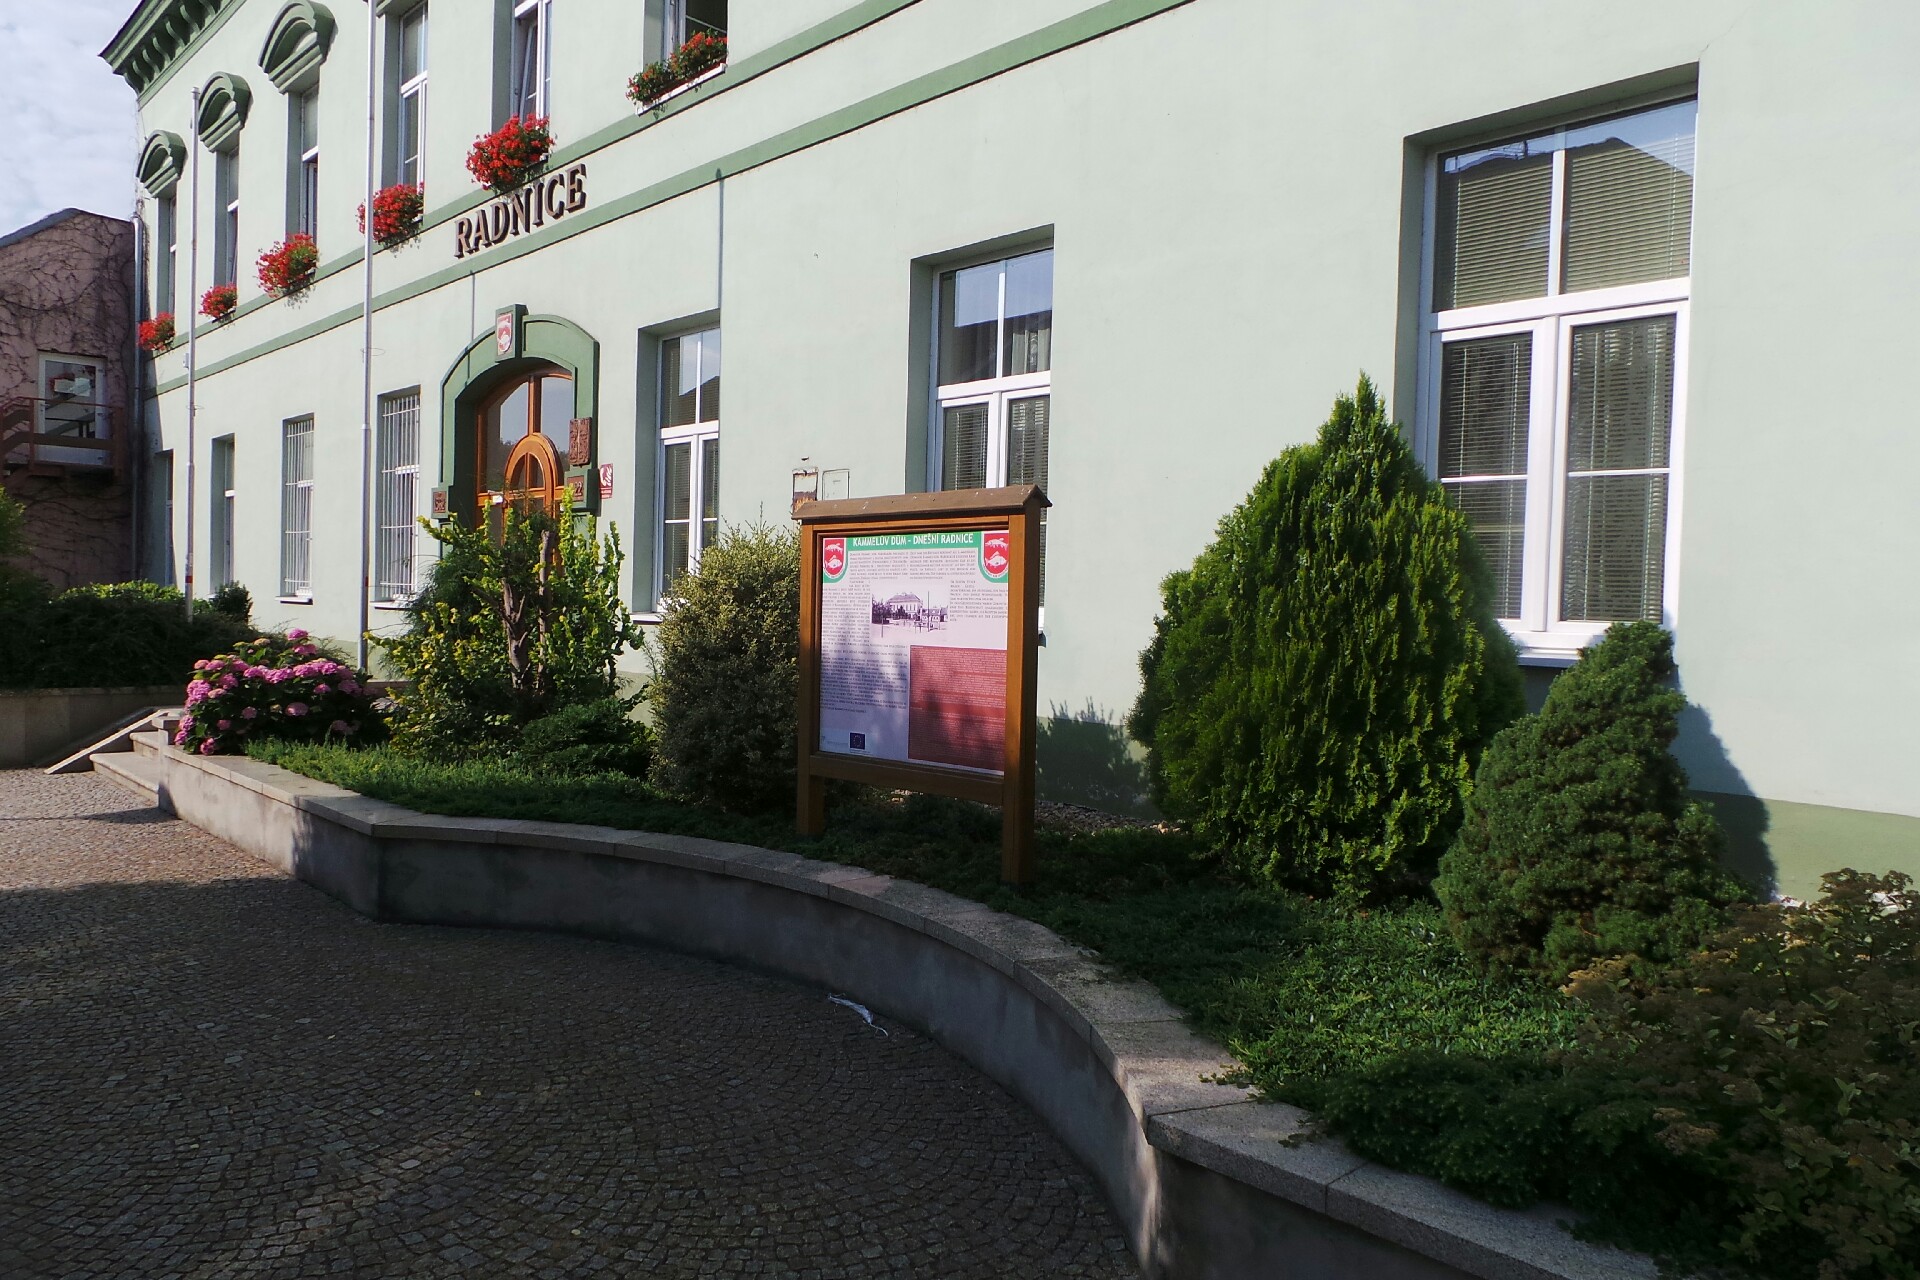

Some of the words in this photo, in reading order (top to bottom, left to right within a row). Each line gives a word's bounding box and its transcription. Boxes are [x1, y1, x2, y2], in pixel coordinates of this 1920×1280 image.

[453, 163, 587, 259] RADNICE
[853, 535, 889, 546] KAMMELŮV
[913, 533, 939, 544] DNEŠNÍ
[941, 533, 973, 544] RADNICE
